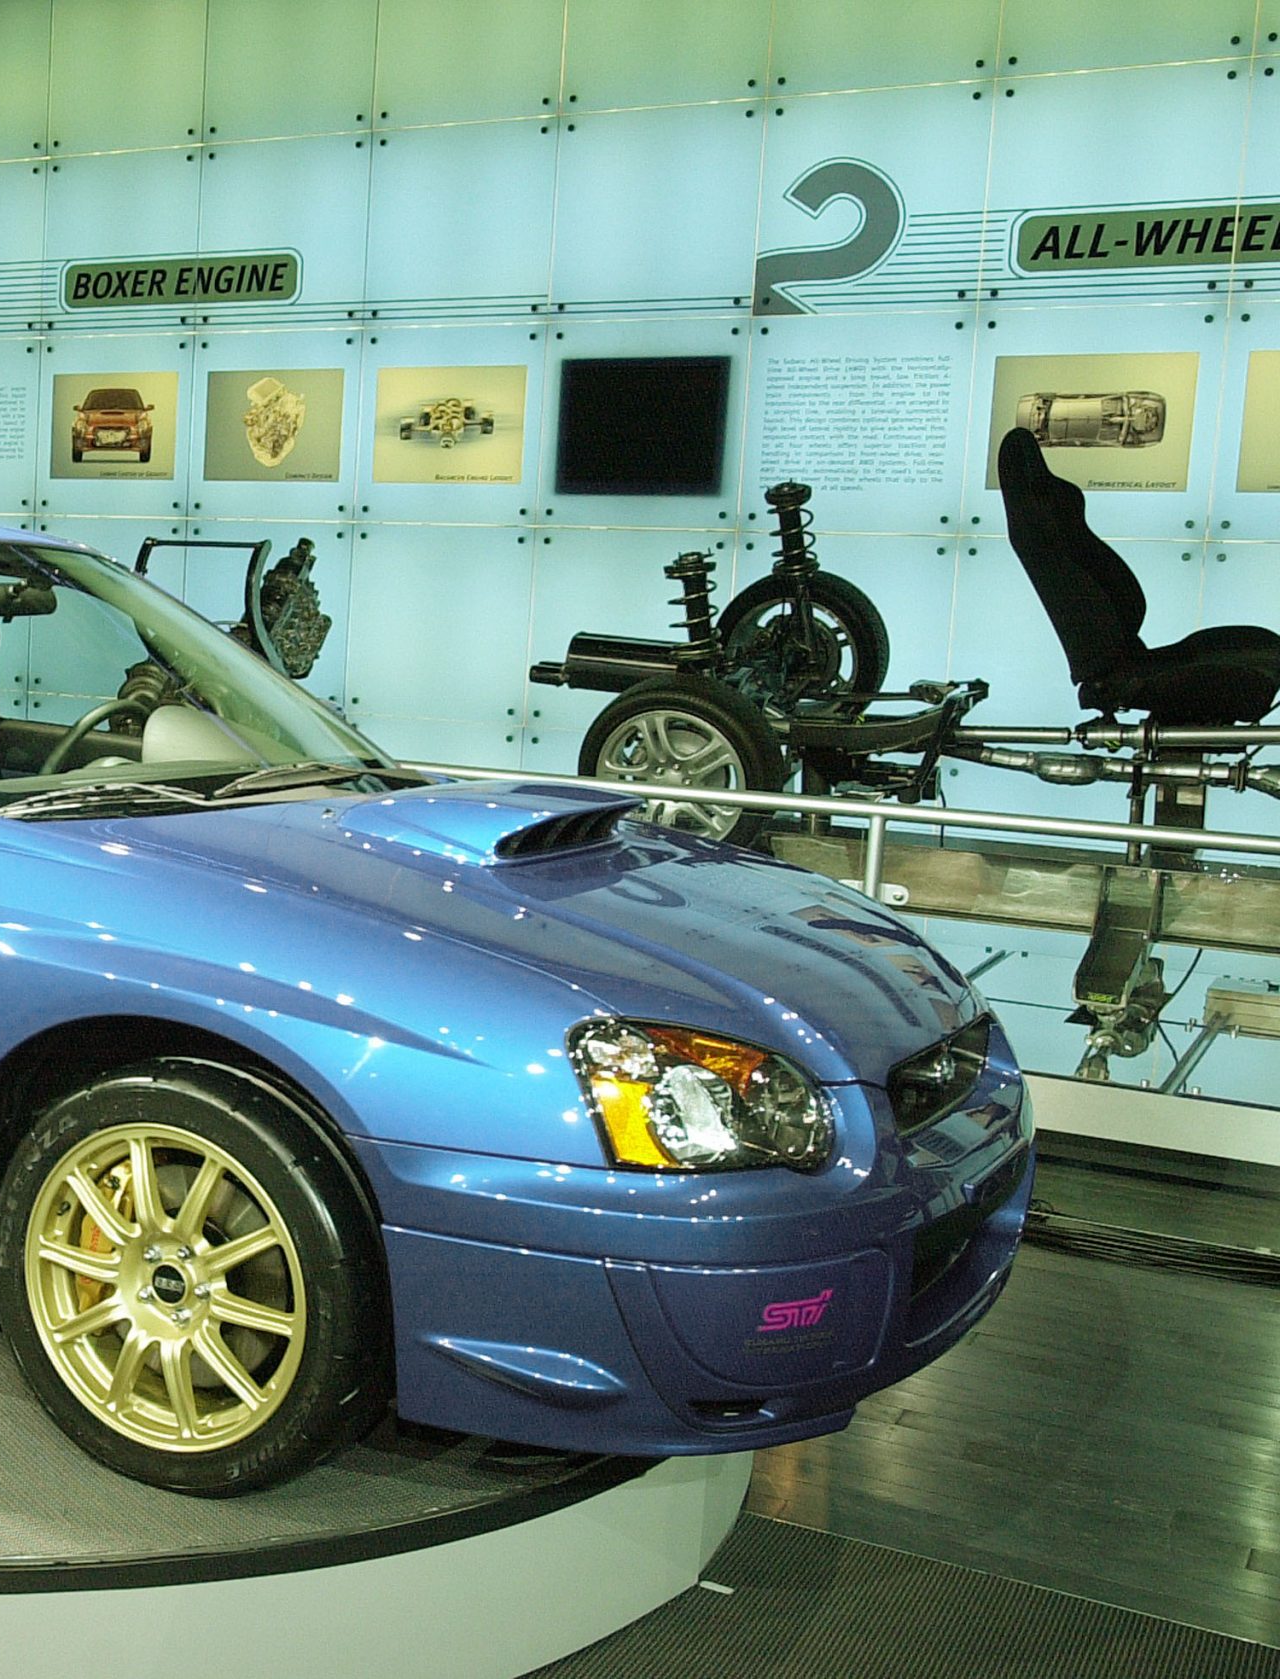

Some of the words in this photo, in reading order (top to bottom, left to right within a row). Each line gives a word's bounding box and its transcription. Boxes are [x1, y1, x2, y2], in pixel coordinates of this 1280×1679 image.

[71, 266, 165, 301] BOXER
[175, 262, 289, 296] ENGINE
[752, 157, 906, 315] 2
